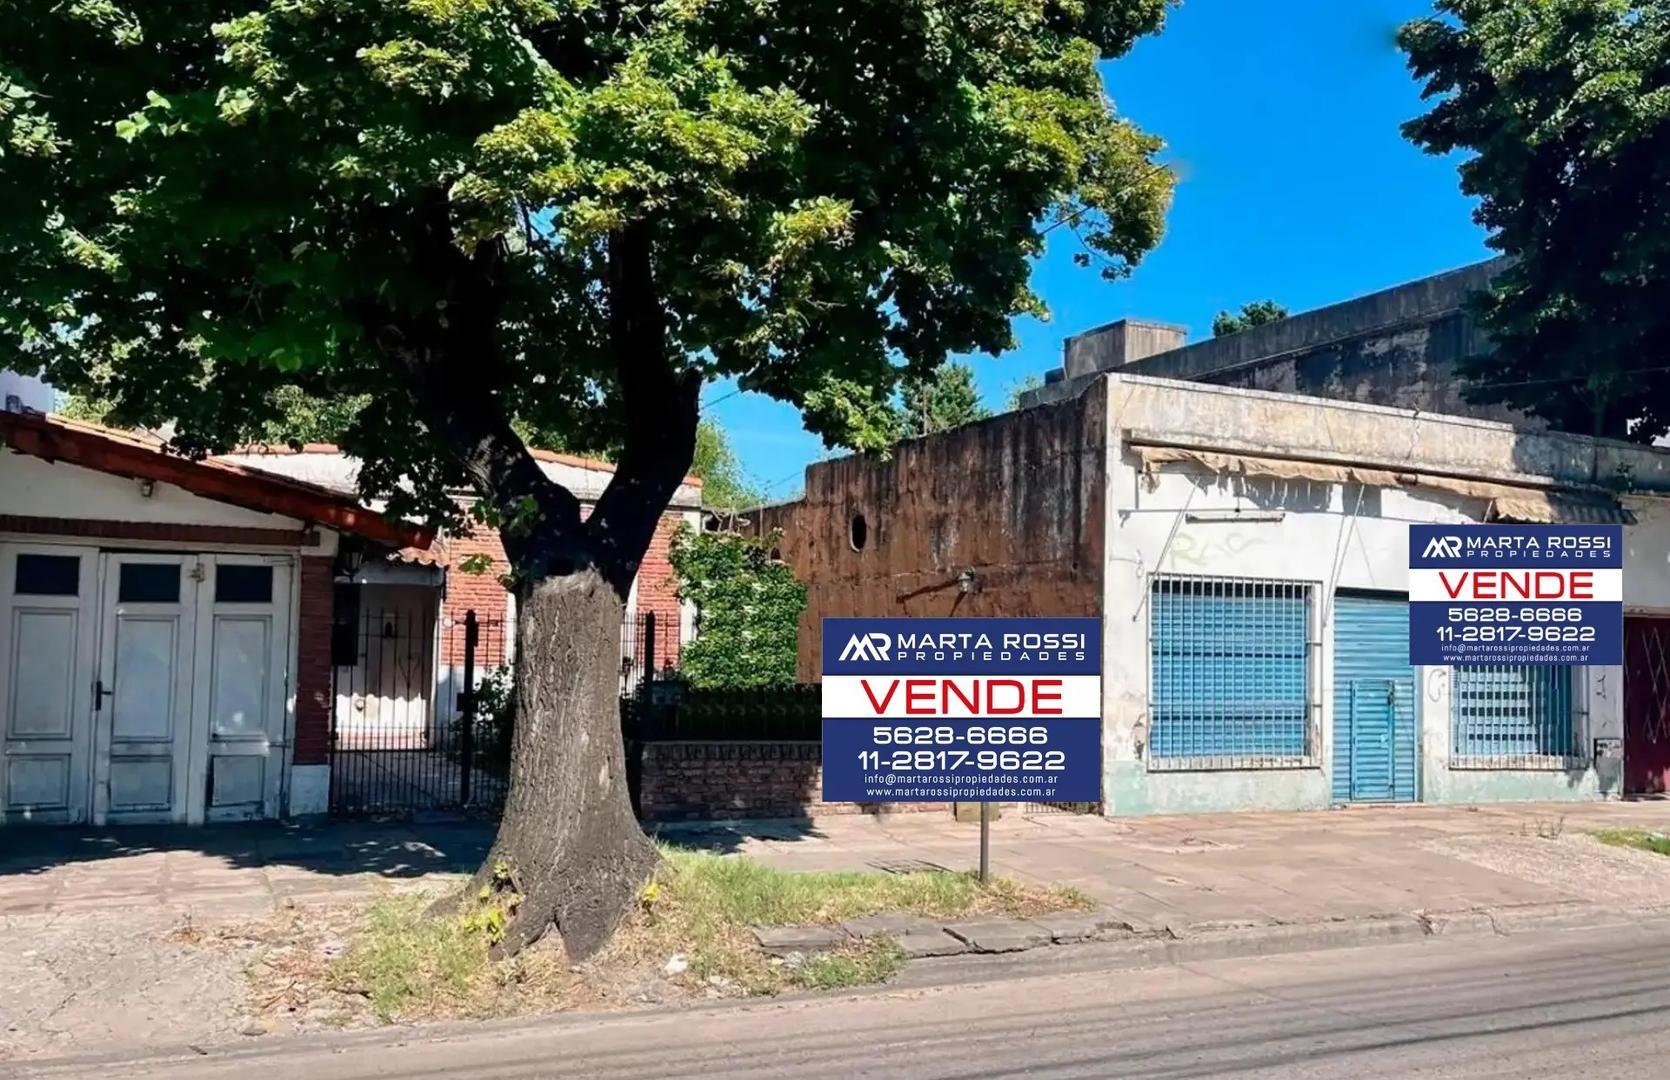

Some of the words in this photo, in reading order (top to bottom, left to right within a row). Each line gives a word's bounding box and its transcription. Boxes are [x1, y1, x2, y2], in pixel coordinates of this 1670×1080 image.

[1467, 537, 1541, 549] MARTA
[1548, 537, 1611, 549] ROSSI
[1439, 572, 1594, 598] VENDE
[1448, 608, 1583, 622] 5628-6666
[1437, 626, 1596, 641] 11-2817-9622
[898, 634, 994, 649] MARTA
[1004, 634, 1086, 649] ROSSI
[1442, 644, 1590, 653] info@martarossipropiedades.com.ar
[898, 652, 1085, 660] PROPIEDADES
[1443, 654, 1589, 662] www.martarossipropiedades.com.ar
[861, 680, 1063, 714] VENDE
[874, 727, 1048, 744] 5628-6666
[858, 751, 1066, 770] 11-2817-9622
[865, 774, 1058, 785] info@martarossipropiedades.com.ar
[867, 787, 1056, 798] www.martarossipropiedades.com.ar
